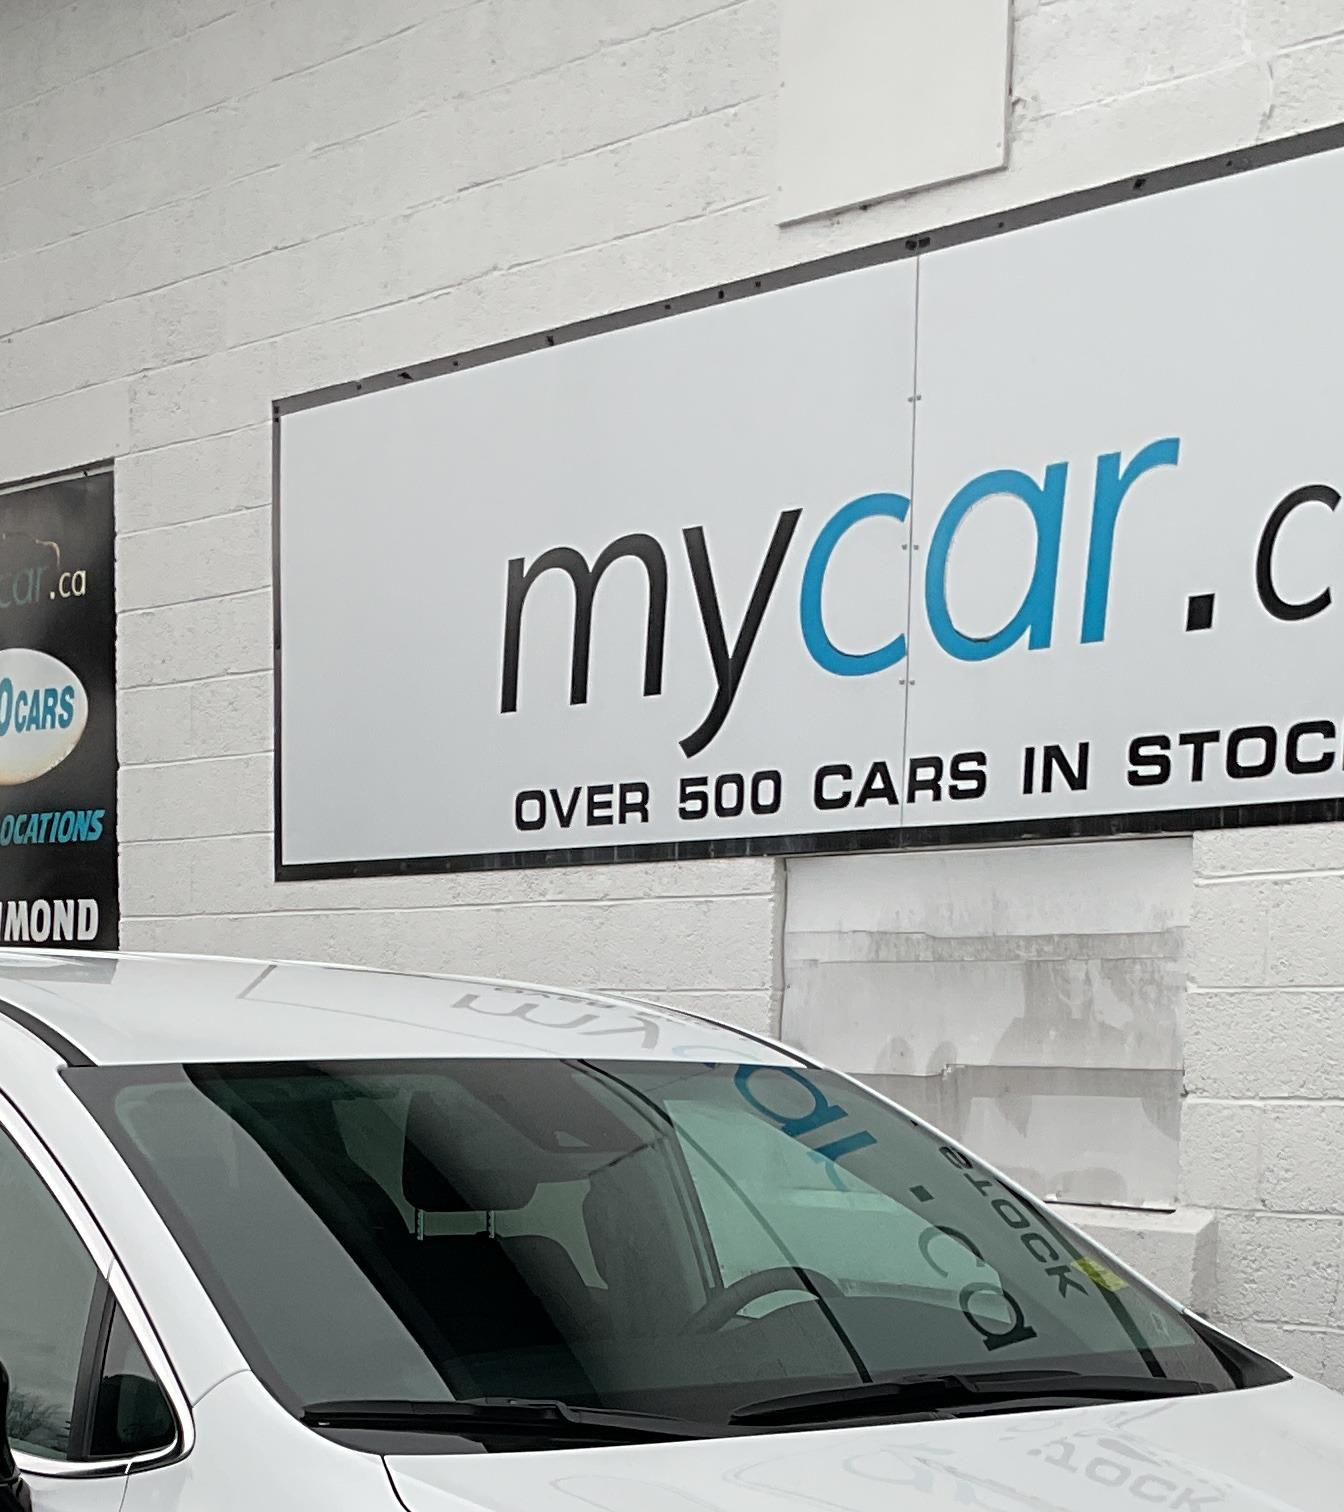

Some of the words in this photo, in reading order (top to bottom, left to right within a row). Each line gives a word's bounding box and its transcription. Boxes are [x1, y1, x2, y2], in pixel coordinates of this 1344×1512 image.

[514, 781, 650, 831] OVER
[677, 769, 783, 821] 500
[813, 751, 987, 810] CARS
[1022, 740, 1089, 794] IN
